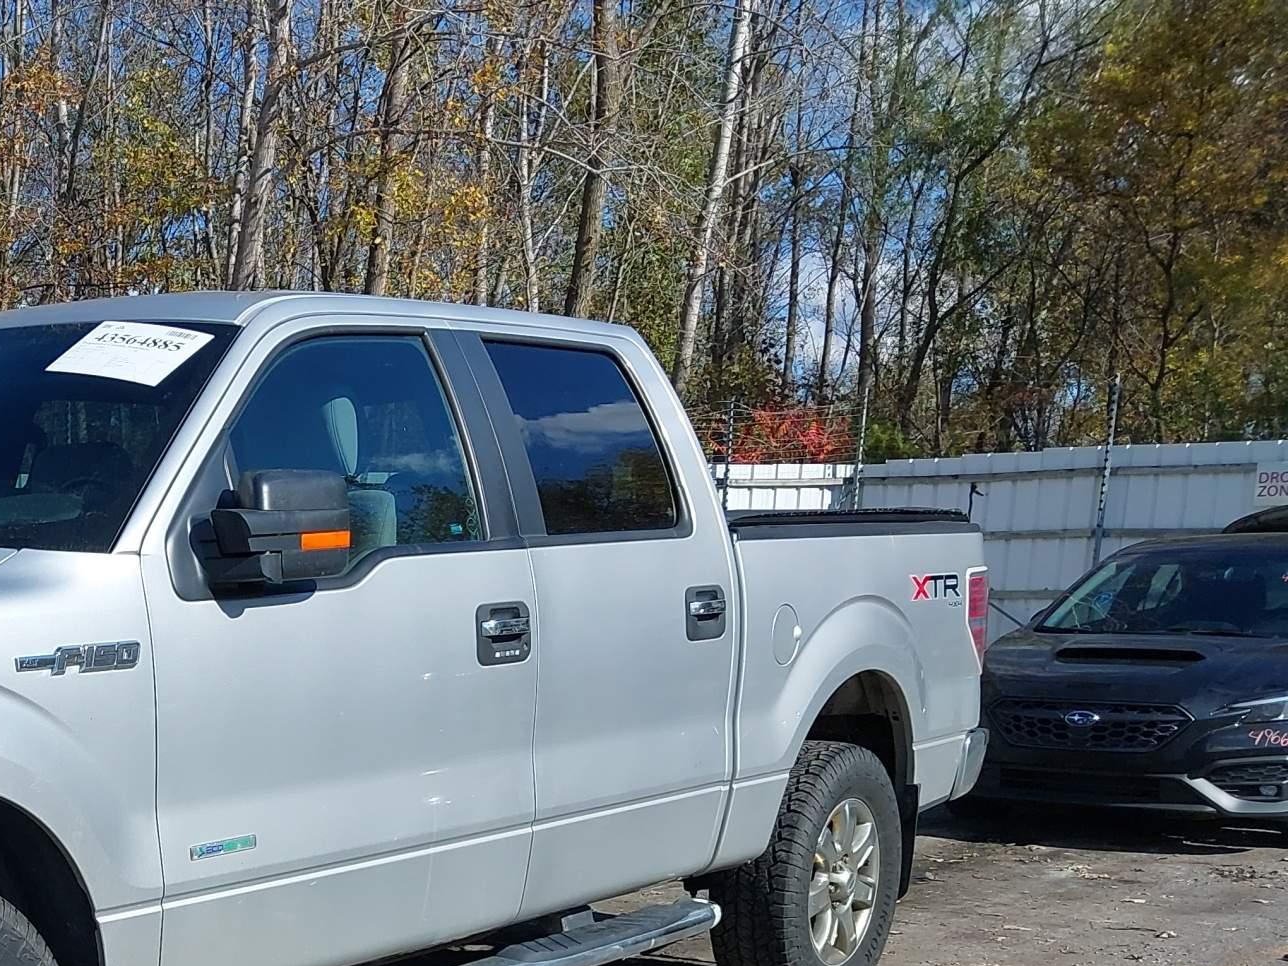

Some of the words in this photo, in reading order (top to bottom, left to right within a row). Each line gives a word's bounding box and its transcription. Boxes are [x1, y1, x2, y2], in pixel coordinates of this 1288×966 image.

[94, 332, 187, 352] 43564885
[911, 573, 961, 601] XTR
[51, 640, 141, 676] F-150
